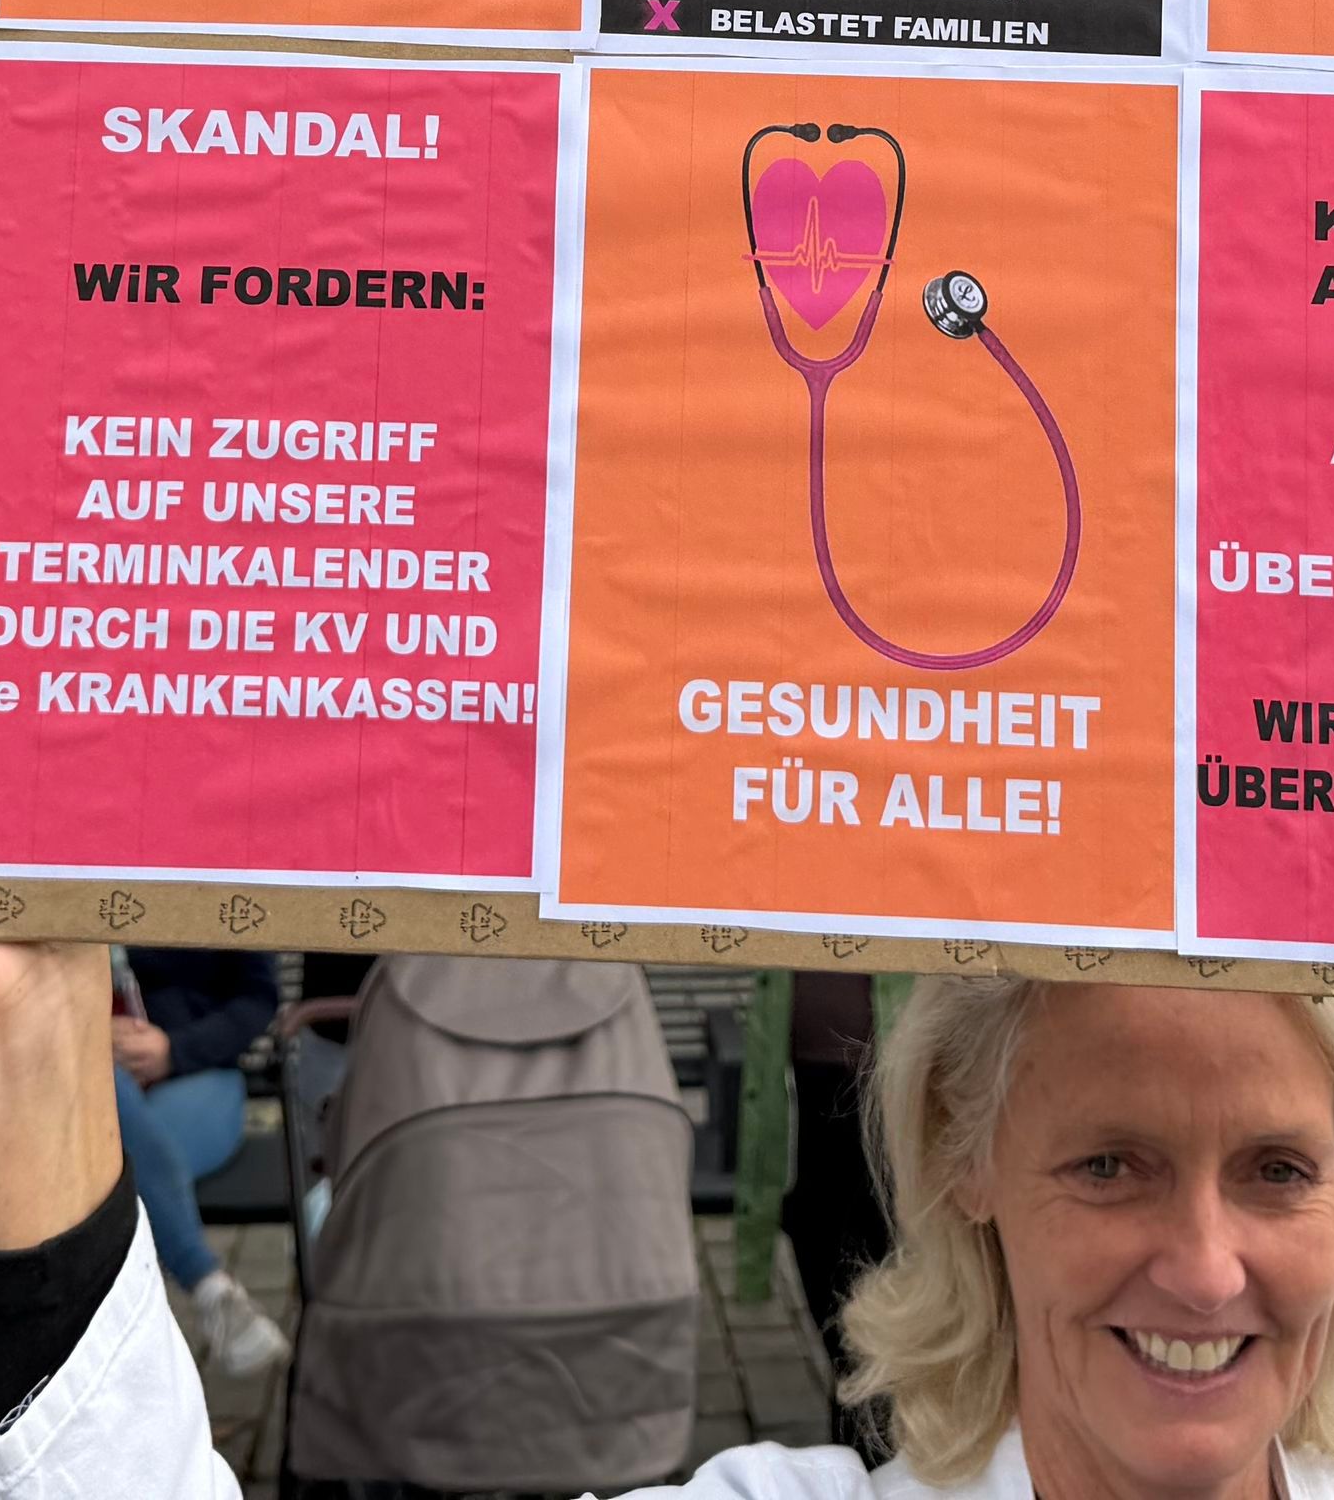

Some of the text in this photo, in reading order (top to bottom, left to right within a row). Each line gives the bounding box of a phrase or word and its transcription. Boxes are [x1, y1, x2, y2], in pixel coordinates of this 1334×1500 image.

[711, 9, 880, 39] BELASTET
[893, 16, 1049, 46] FAMILIEN
[101, 106, 440, 159] SKANDAL!
[74, 263, 485, 311] WiR FORDERN:
[64, 415, 438, 462] KEIN ZUGRIFF
[77, 479, 416, 526] AUF UNSERE
[188, 609, 276, 652] DIE
[294, 611, 369, 653] KV
[385, 613, 498, 657] UND
[38, 671, 536, 724] KRANKENKASSEN!
[678, 678, 1101, 750] GESUNDHEIT
[732, 757, 1062, 836] FÜR ALLE!
[0, 899, 10, 912] 21
[98, 898, 106, 920] PAP
[119, 903, 130, 916] 21
[219, 902, 228, 924] PAP
[239, 907, 251, 920] 21
[339, 907, 348, 929] PAP
[359, 912, 371, 925] 21
[459, 910, 468, 932] PAP
[479, 916, 491, 928] 21
